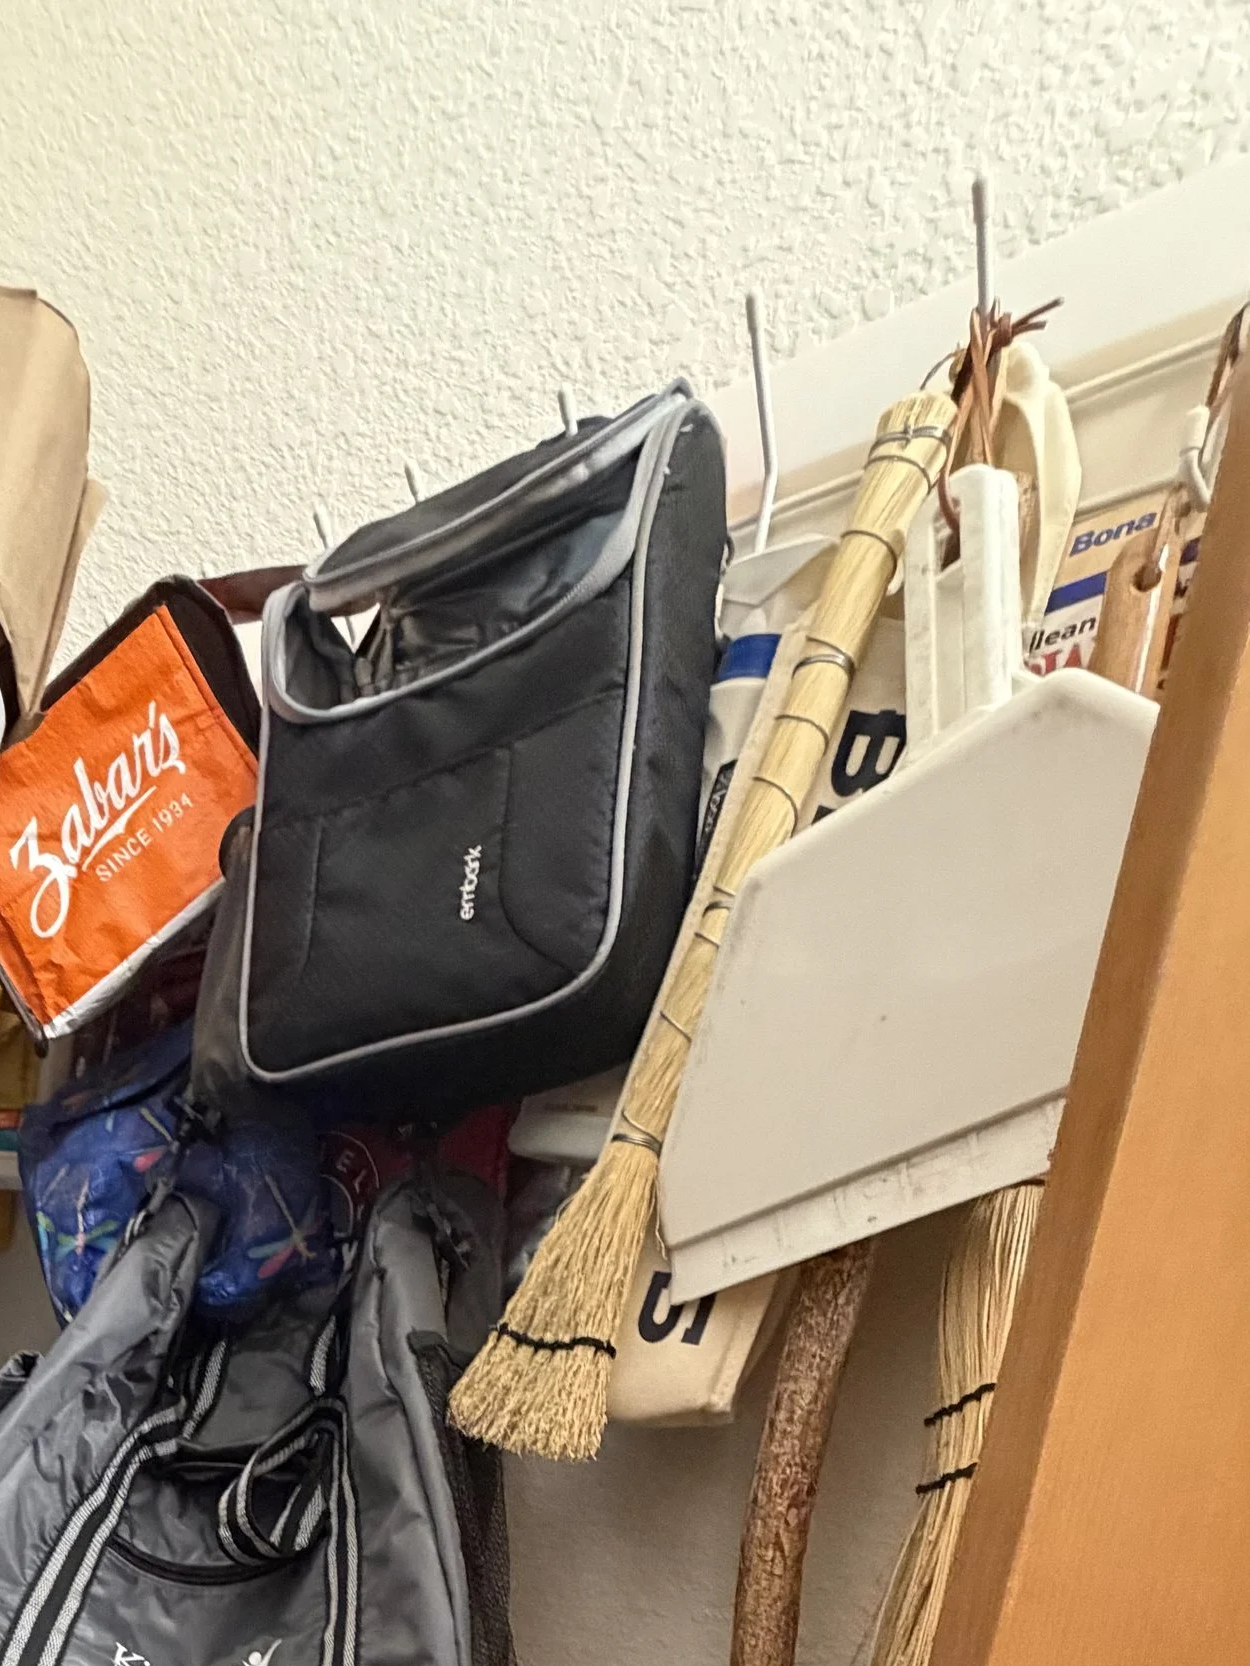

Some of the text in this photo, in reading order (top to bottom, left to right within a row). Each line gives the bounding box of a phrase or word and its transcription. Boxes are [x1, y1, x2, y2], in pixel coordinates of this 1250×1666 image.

[1069, 512, 1158, 557] Bona
[9, 700, 186, 939] Zabar's
[95, 792, 194, 882] SINCE 1934
[459, 844, 483, 920] embark
